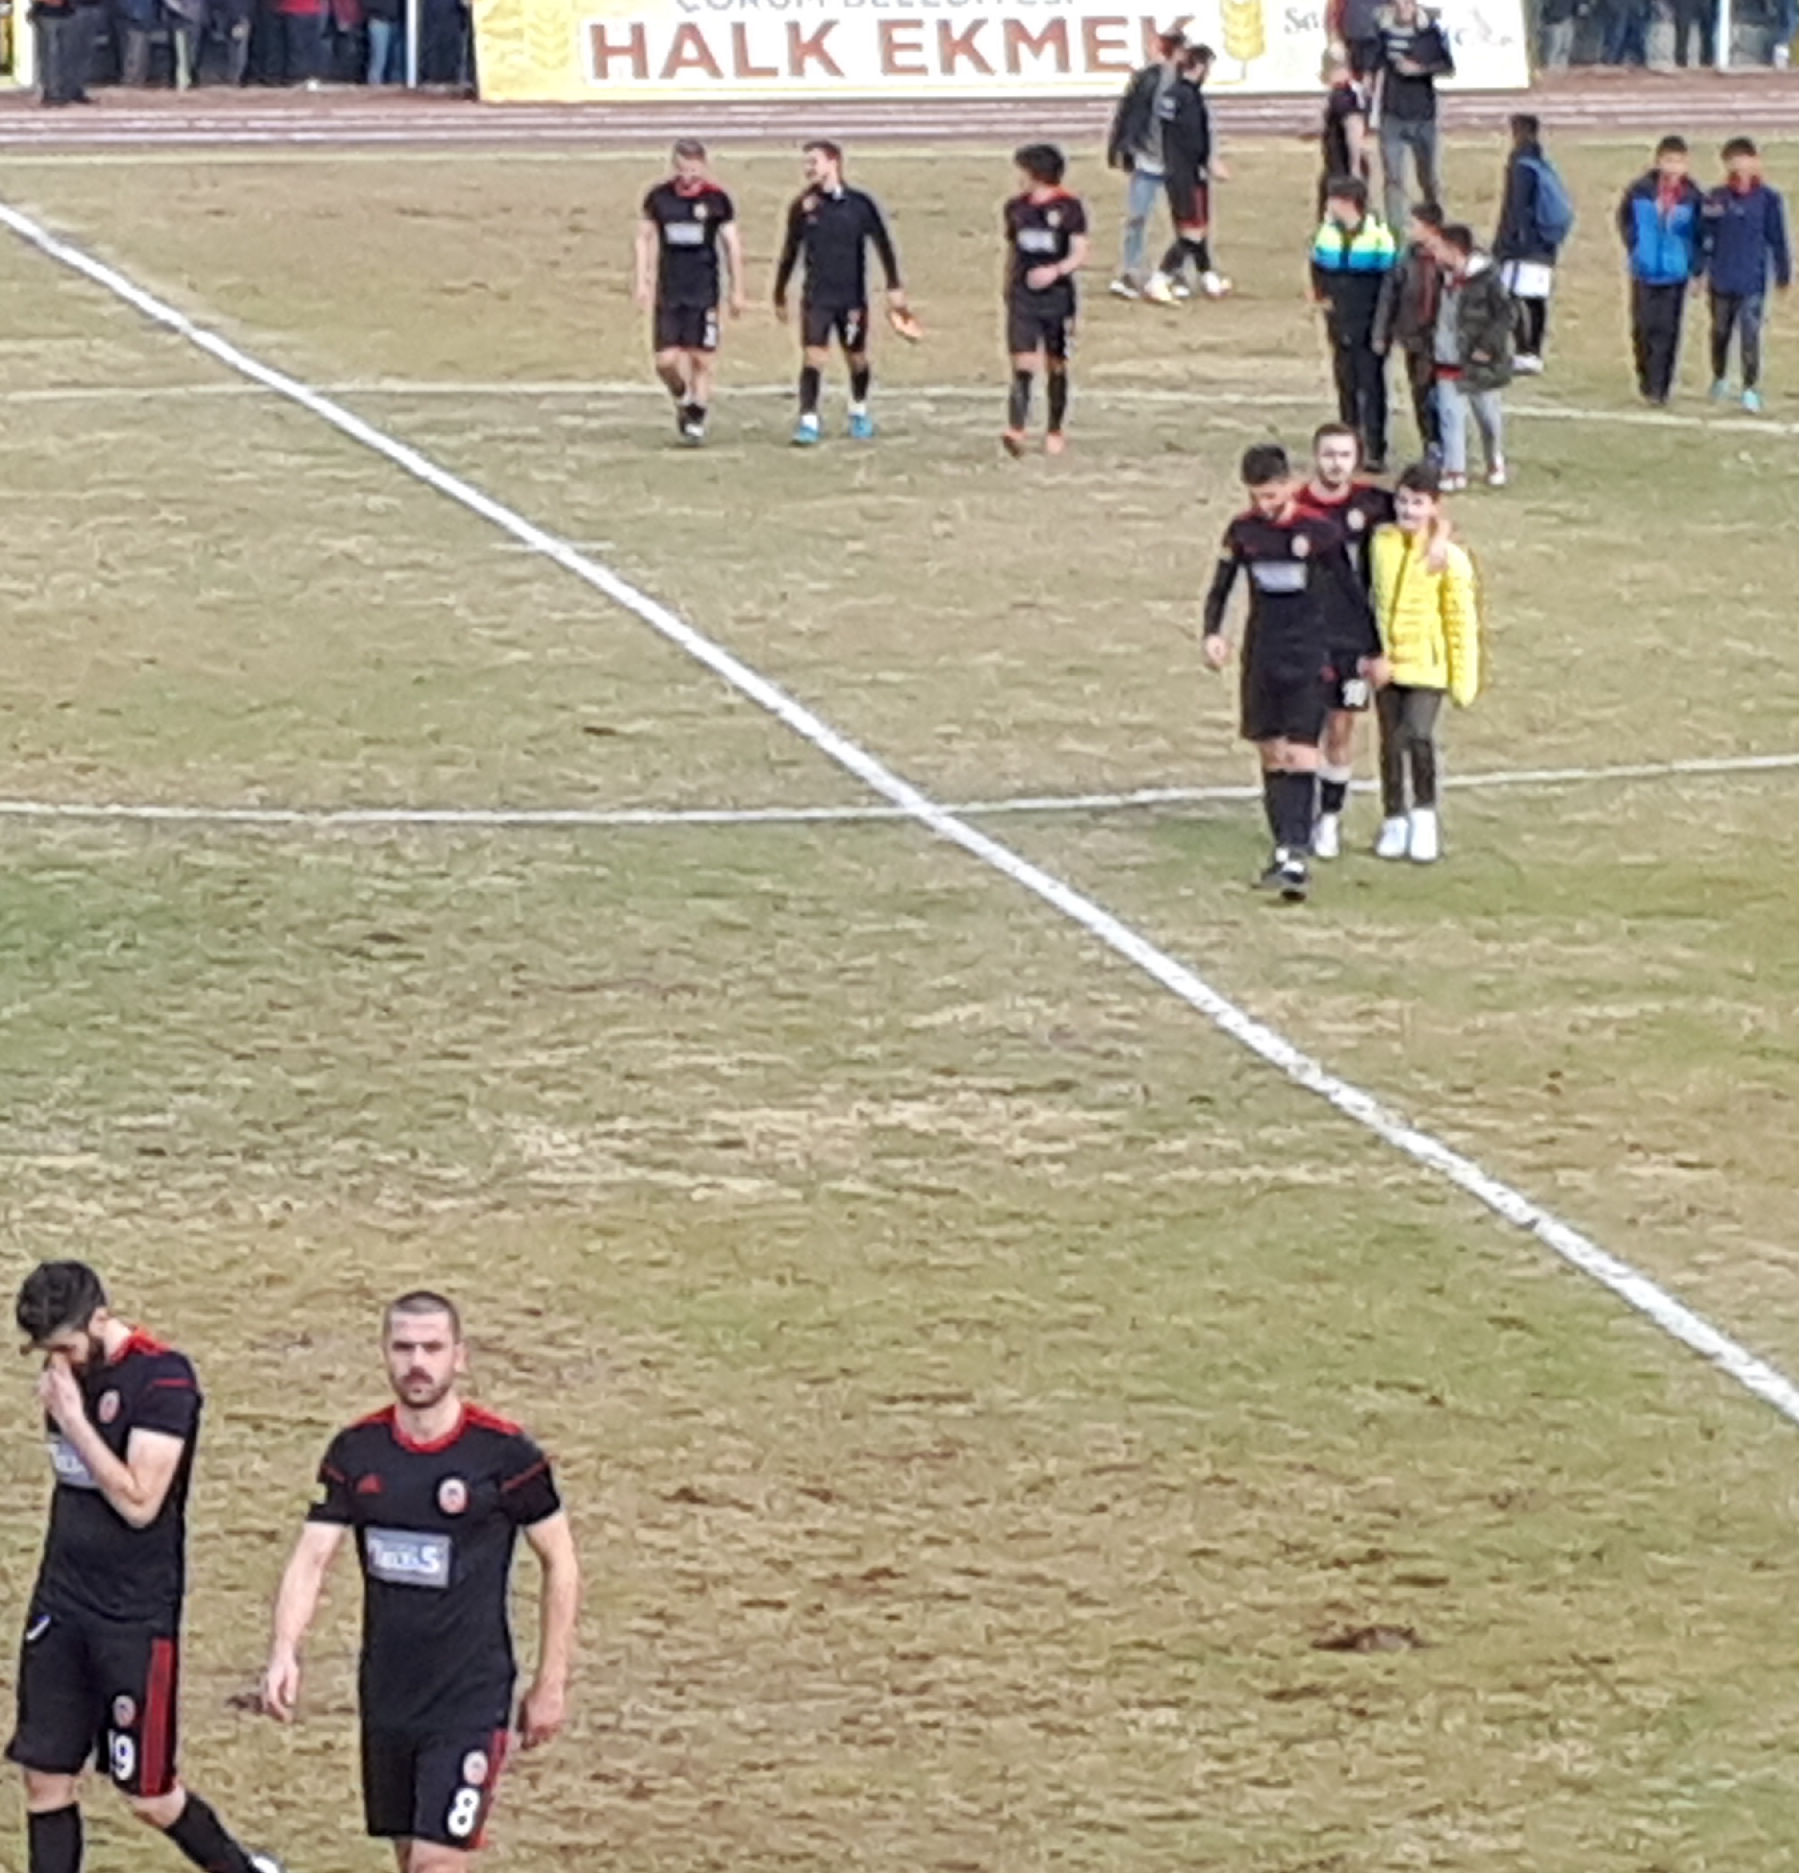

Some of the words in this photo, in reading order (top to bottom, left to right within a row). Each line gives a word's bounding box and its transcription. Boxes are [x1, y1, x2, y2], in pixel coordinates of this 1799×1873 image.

[589, 19, 846, 80] HALK
[876, 15, 1196, 77] EKMEK
[447, 1788, 481, 1837] 8
